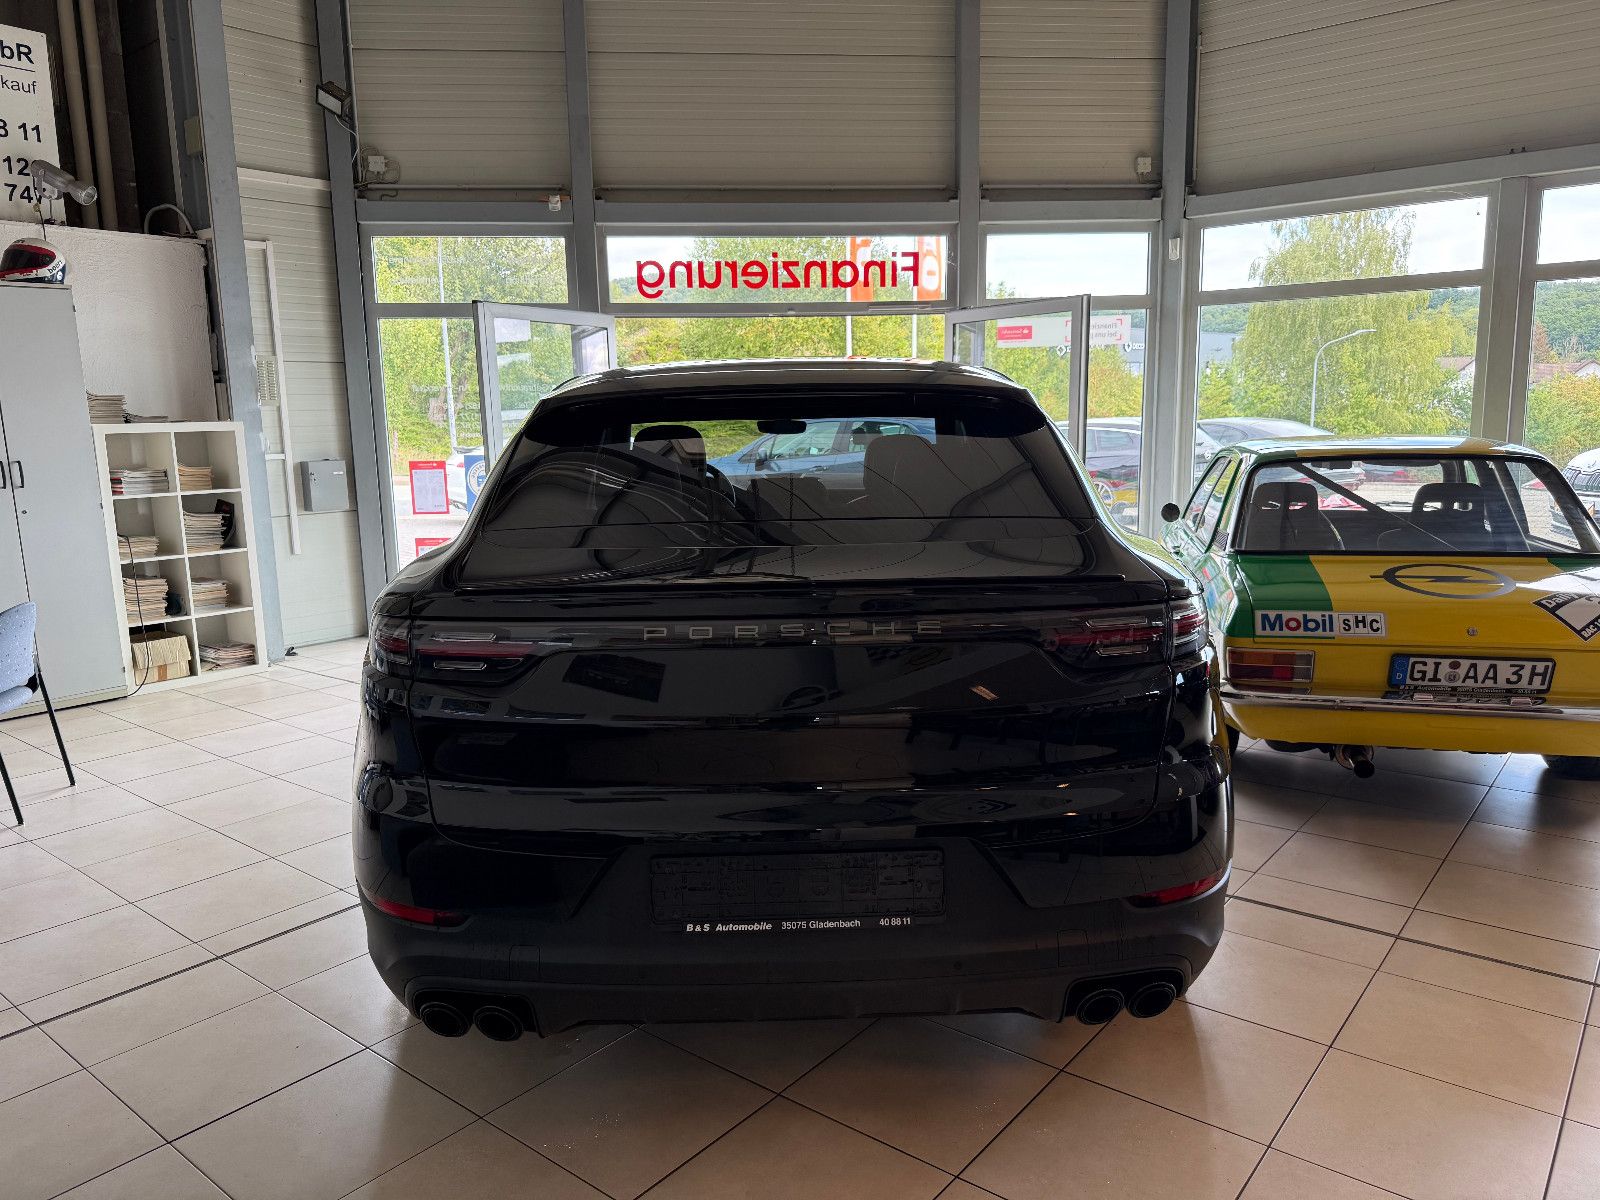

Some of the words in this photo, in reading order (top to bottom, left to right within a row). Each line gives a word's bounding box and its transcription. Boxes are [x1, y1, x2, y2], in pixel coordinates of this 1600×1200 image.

[0, 75, 37, 94] kauf
[18, 122, 41, 143] 11
[643, 620, 942, 640] PORSCHE
[1260, 613, 1334, 633] Mobil
[1342, 615, 1381, 634] SHC
[1581, 624, 1597, 638] RAC
[1396, 672, 1402, 680] D
[1408, 660, 1441, 683] GI
[1461, 662, 1498, 685] AA
[1505, 663, 1550, 686] 3H
[686, 923, 694, 932] B
[694, 923, 702, 931] &
[702, 923, 710, 931] S
[715, 922, 772, 932] Automobile
[781, 920, 807, 929] 35075
[809, 919, 861, 929] Gladenbach
[879, 918, 890, 926] 40
[890, 917, 902, 926] 88
[902, 917, 911, 925] 11
